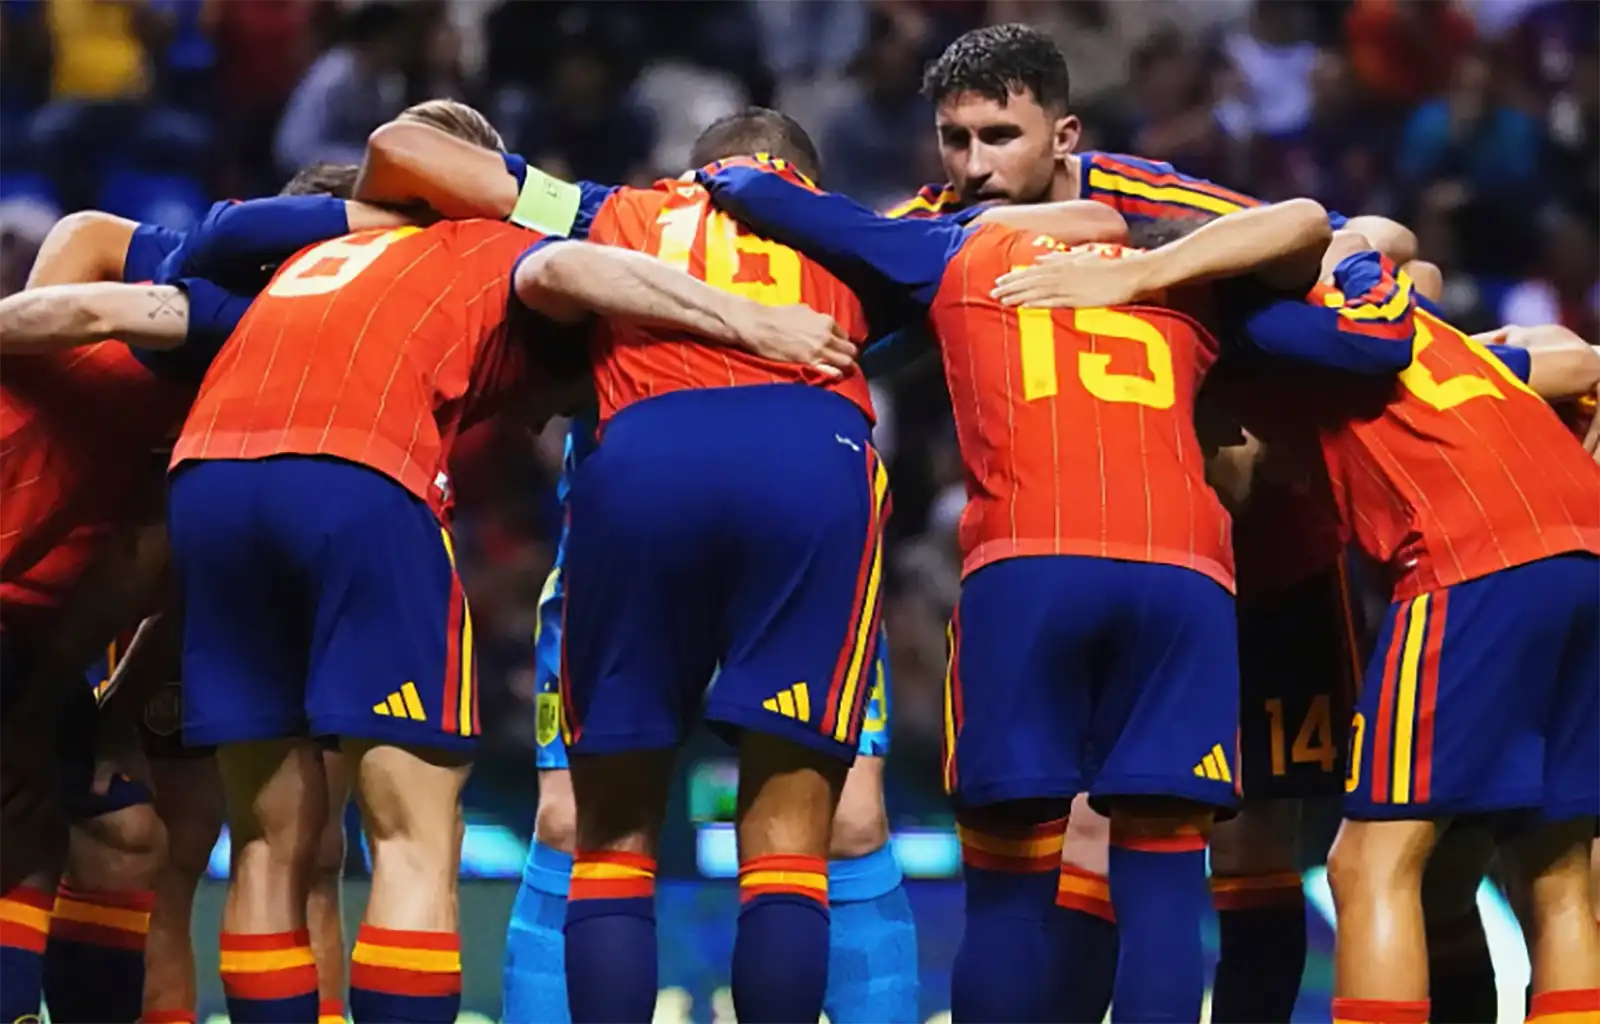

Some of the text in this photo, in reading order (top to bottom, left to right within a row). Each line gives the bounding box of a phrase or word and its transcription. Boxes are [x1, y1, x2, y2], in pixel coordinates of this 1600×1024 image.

[656, 203, 802, 307] 16
[1011, 265, 1176, 410] 15
[1264, 694, 1338, 776] 14
